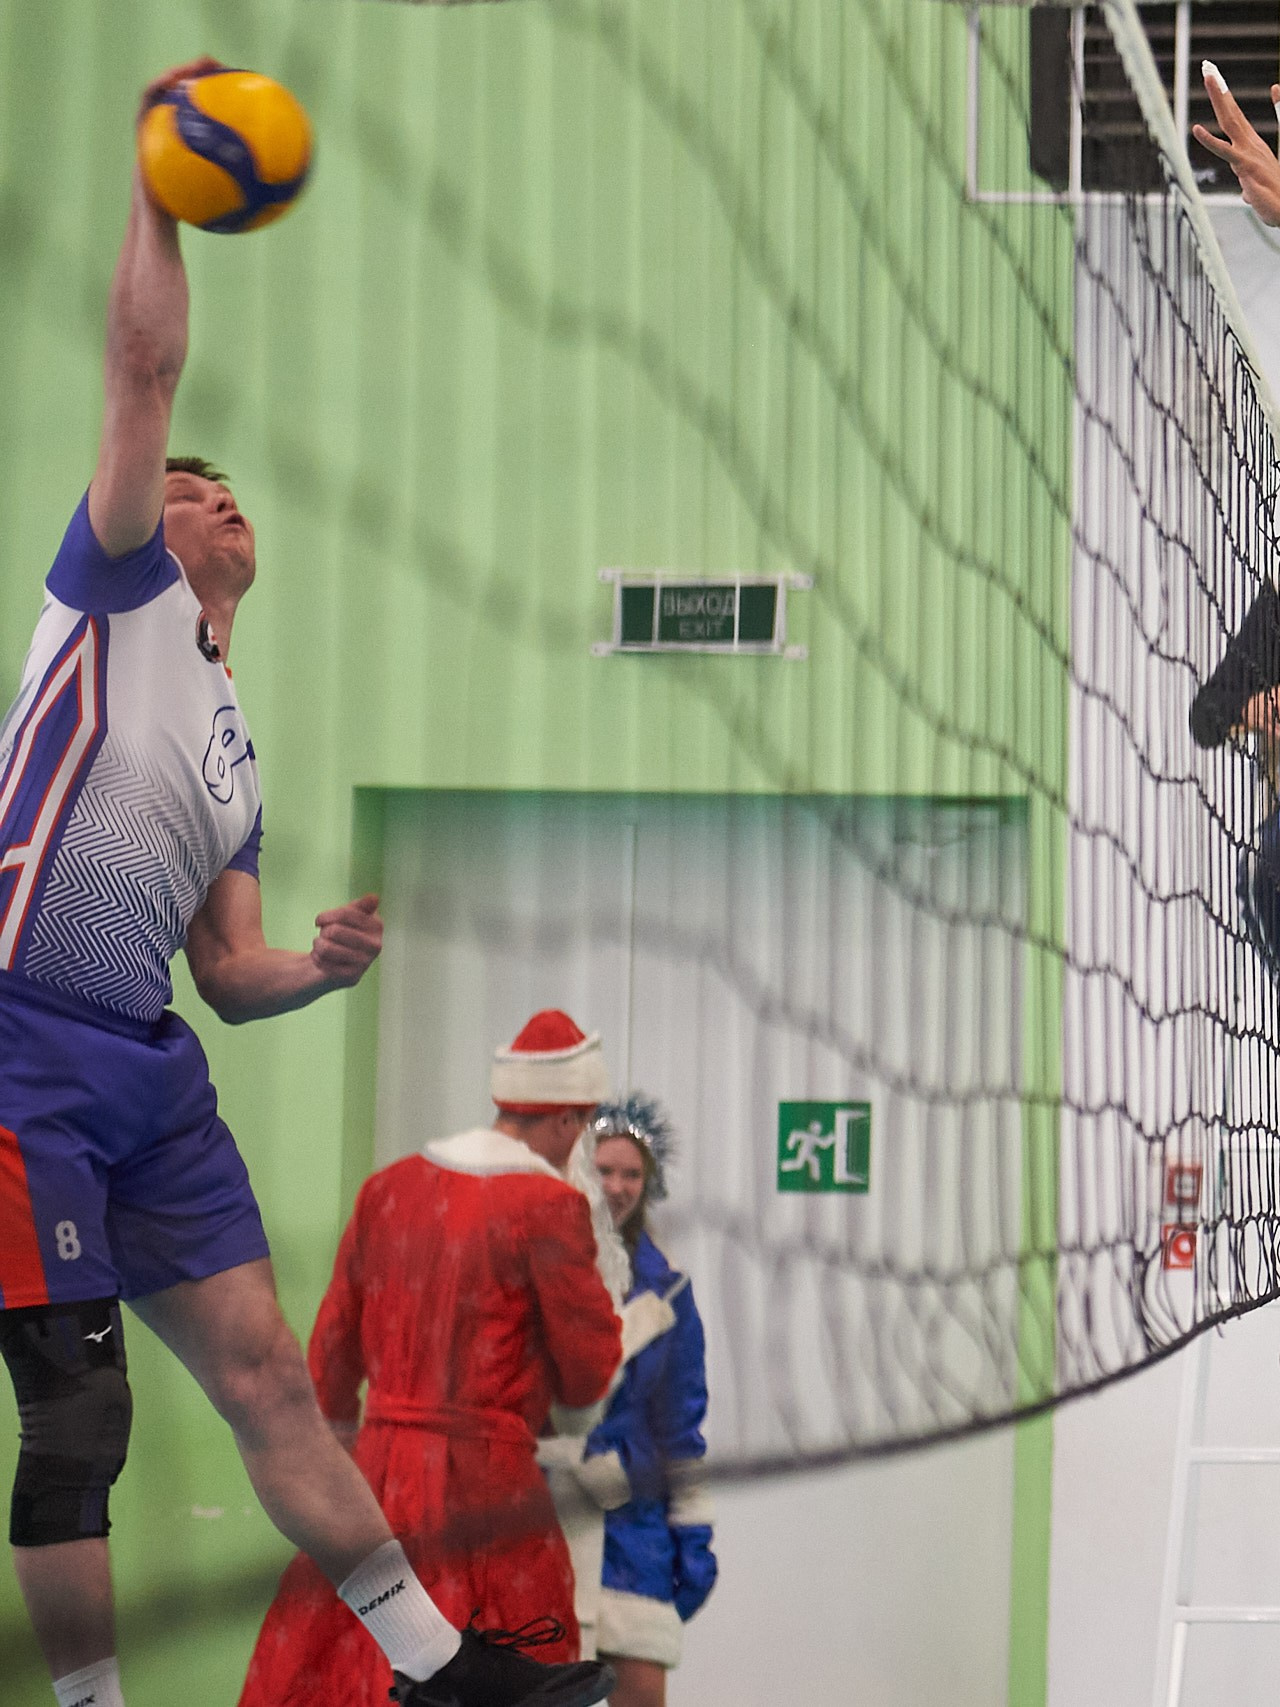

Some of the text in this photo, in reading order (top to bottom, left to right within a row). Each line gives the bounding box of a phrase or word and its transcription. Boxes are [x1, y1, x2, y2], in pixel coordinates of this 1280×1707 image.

[663, 590, 735, 617] ВЫХОД
[679, 619, 724, 638] EXIT
[55, 1219, 81, 1260] 8
